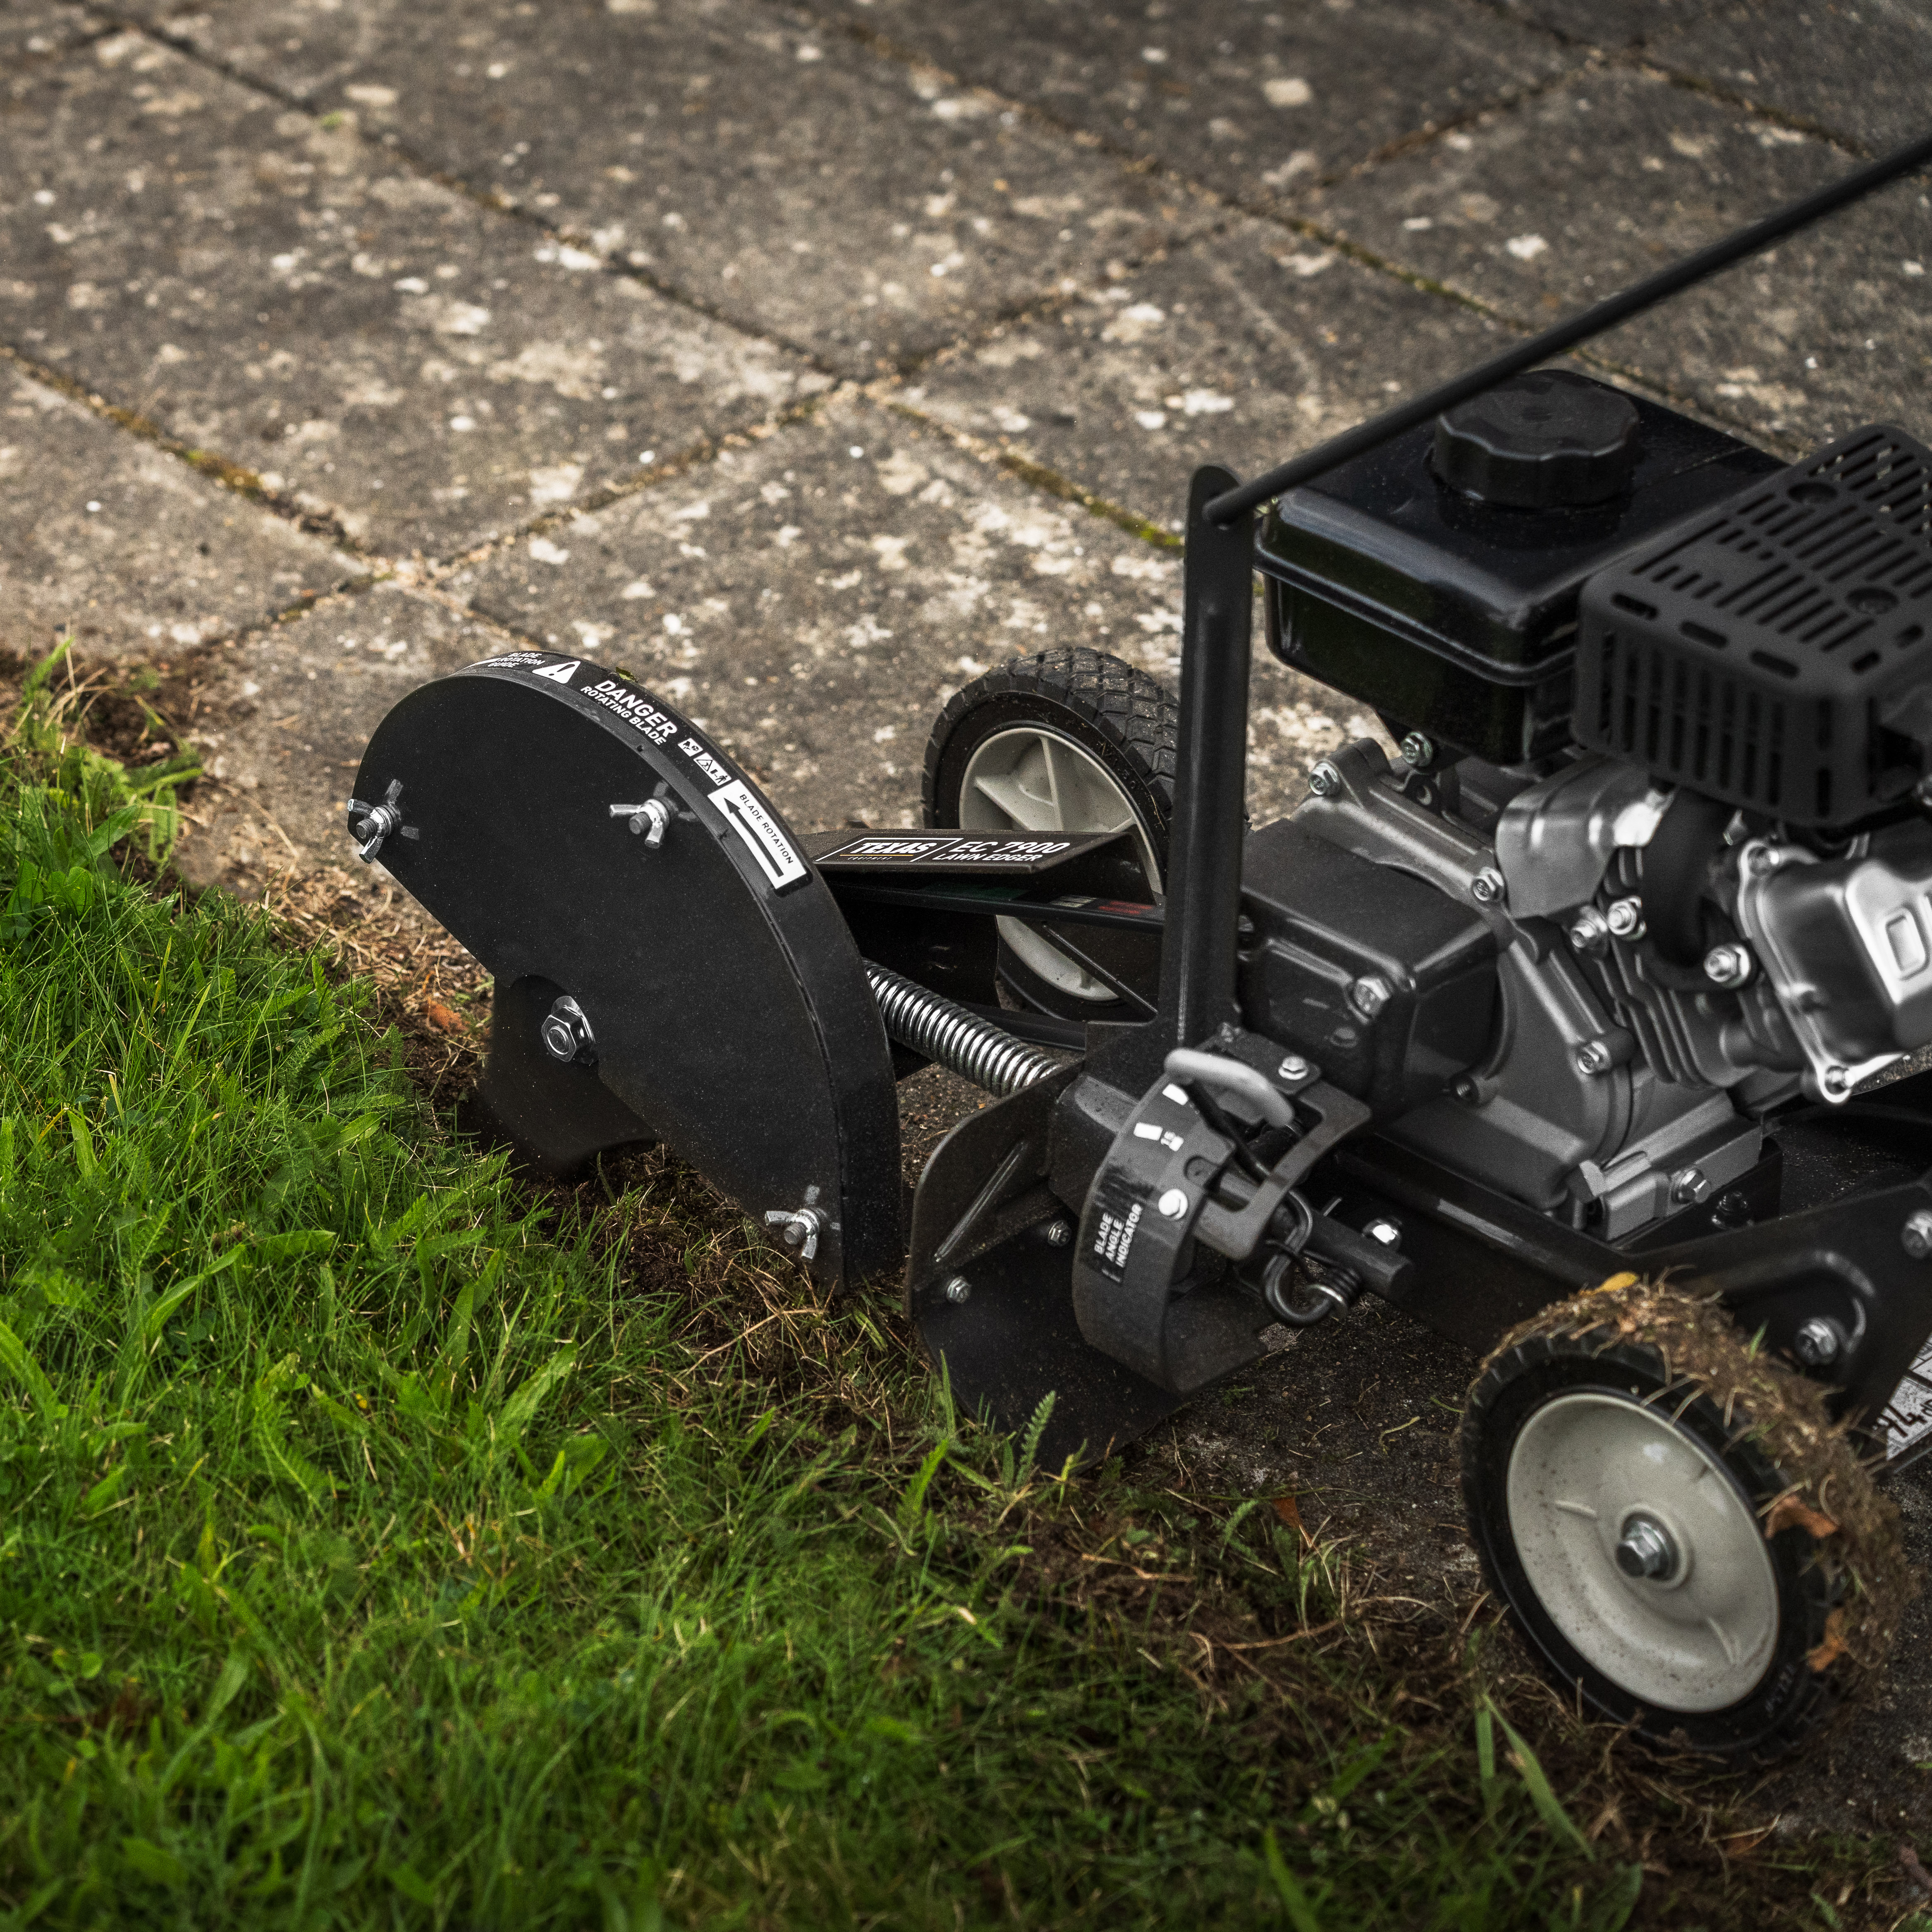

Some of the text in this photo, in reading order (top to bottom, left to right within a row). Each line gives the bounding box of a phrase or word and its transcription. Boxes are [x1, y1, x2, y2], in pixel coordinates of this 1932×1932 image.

[497, 657, 545, 665] ROTATION
[580, 686, 667, 745] ROTATING BLADE
[594, 679, 678, 738] DANGER
[739, 794, 794, 864] BLADE ROTATION
[850, 842, 937, 854] TEXAS
[949, 842, 1071, 854] EC 7900
[982, 853, 1043, 861] EDGER
[1094, 1212, 1114, 1255] BLADE
[1105, 1219, 1124, 1262] ANGLE
[1115, 1203, 1143, 1268] INDICATOR
